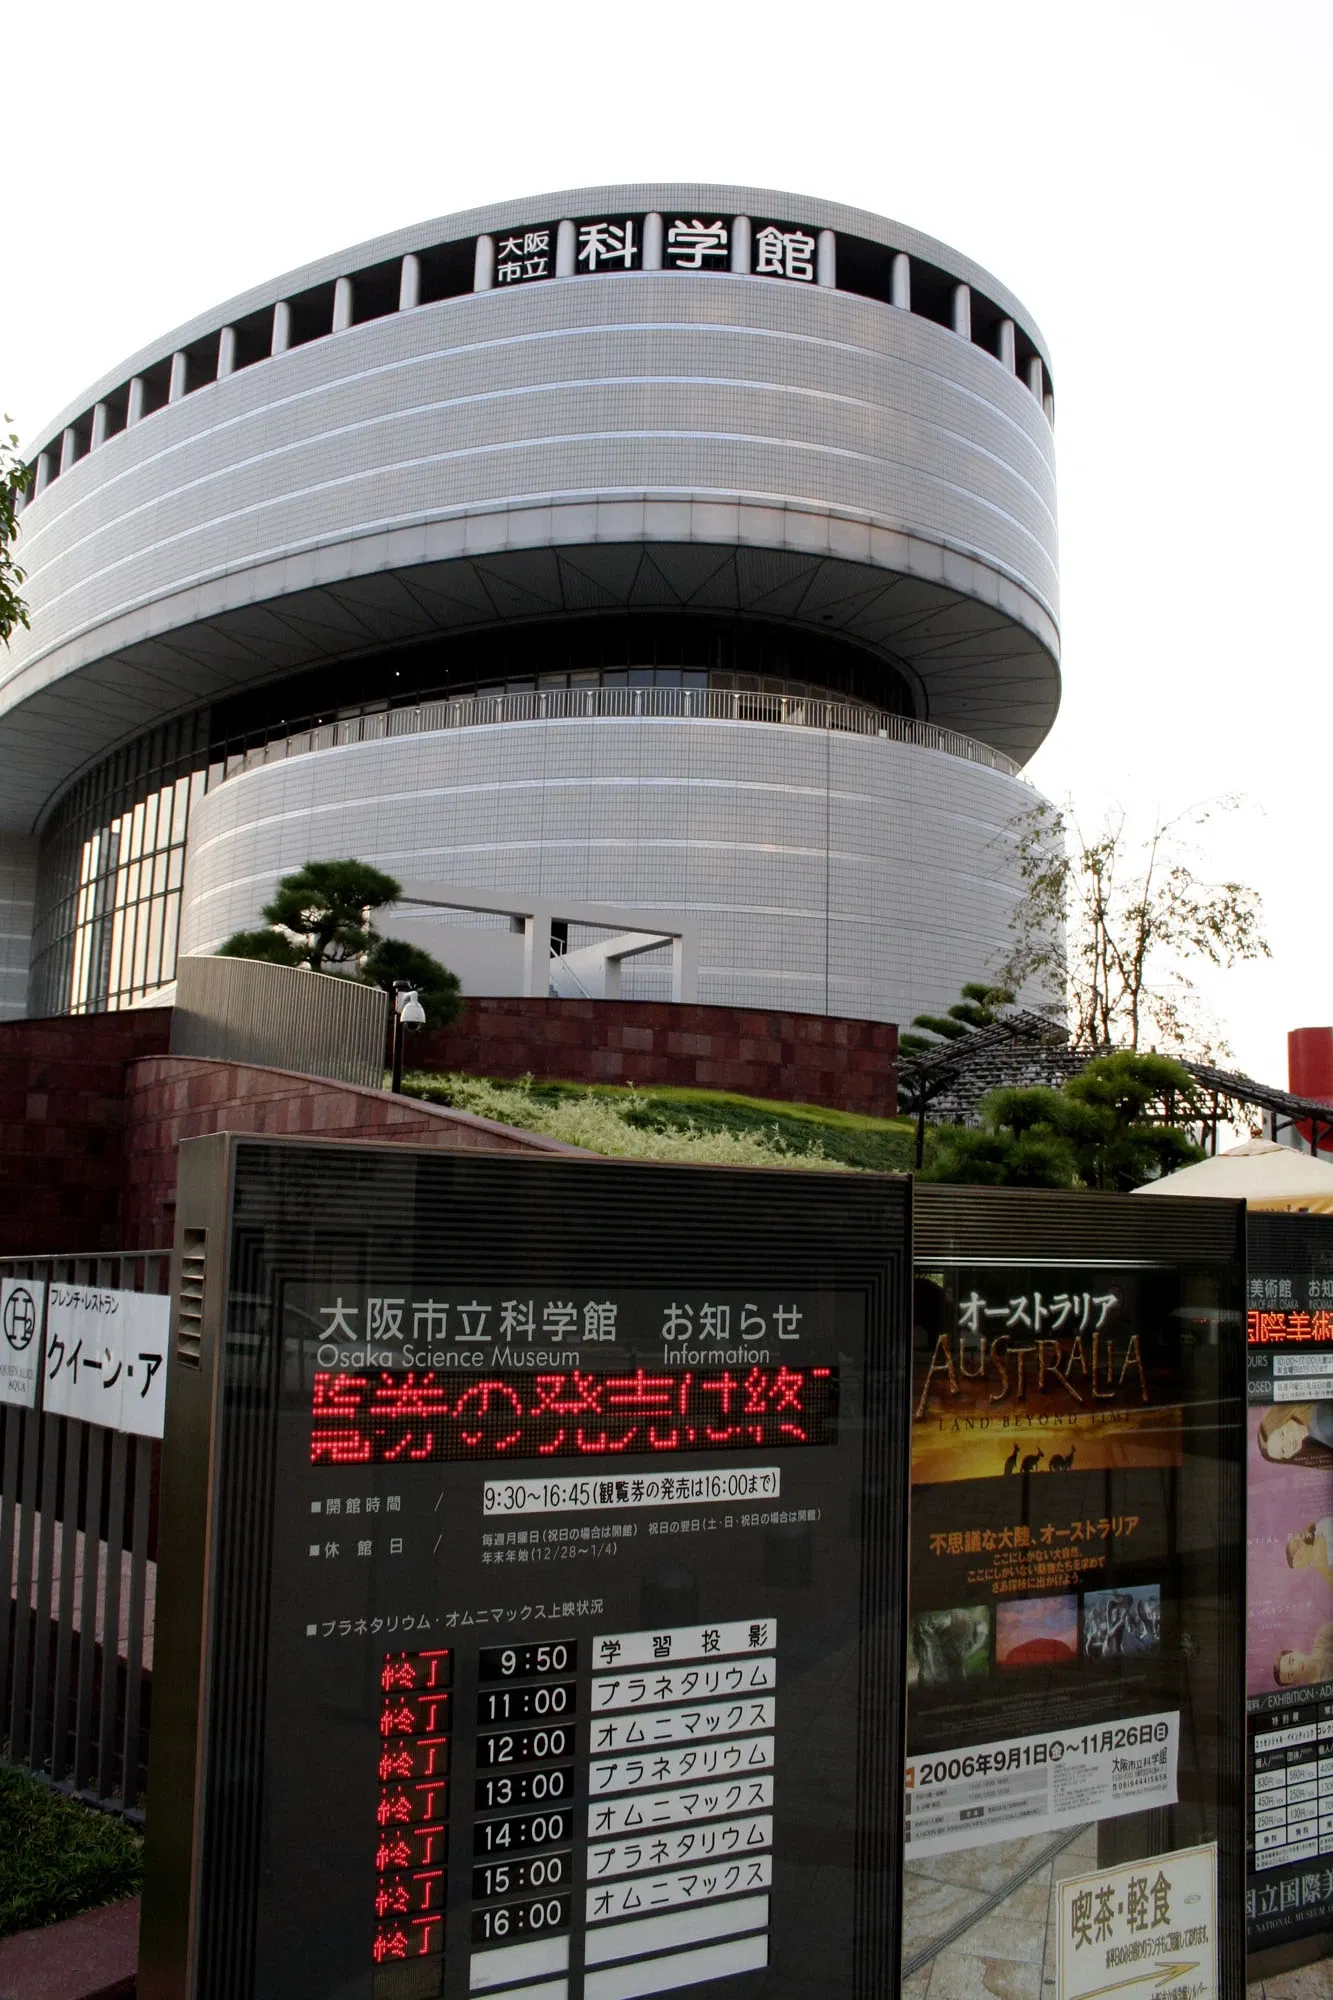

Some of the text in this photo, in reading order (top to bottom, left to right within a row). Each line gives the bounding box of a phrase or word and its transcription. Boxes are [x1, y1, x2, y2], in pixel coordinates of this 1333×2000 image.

[499, 230, 550, 258] 大阪
[579, 220, 815, 281] 科学館
[497, 257, 549, 282] 市立
[51, 1288, 119, 1315] フレンチ・レストラン
[1247, 1279, 1292, 1298] 美術館
[318, 1298, 803, 1343] 大阪市立科学館 お知らせ
[958, 1291, 1118, 1332] オーストラリア
[317, 1344, 770, 1368] Osaka Science Museum Information
[914, 1331, 1149, 1419] AUSTRALIA
[938, 1415, 991, 1432] LAND
[1002, 1412, 1078, 1428] BEYOND
[326, 1496, 402, 1516] 開館時間
[322, 1598, 604, 1637] プラネタリウム・オムニマックス上映状況
[501, 1645, 568, 1675] 9:50
[600, 1623, 768, 1665] 学習投影
[489, 1687, 567, 1720] 11:00
[598, 1665, 768, 1706] プラネタリウム
[1267, 1688, 1315, 1708] EXHIBITION
[597, 1703, 766, 1747] オムニマックス
[488, 1729, 566, 1763] 12:00
[1110, 1746, 1169, 1774] 大阪市立科学館
[596, 1743, 766, 1790] プラネタリウム
[486, 1771, 564, 1806] 13:00
[595, 1783, 765, 1831] オムニマックス
[485, 1815, 564, 1850] 14:00
[594, 1823, 764, 1874] プラネタリウム
[485, 1858, 562, 1895] 15:00
[593, 1863, 763, 1915] オムニマックス
[483, 1900, 562, 1938] 16:00
[1071, 1870, 1172, 1951] 喫茶・軽食
[1256, 1916, 1293, 1933] NATIONAL
